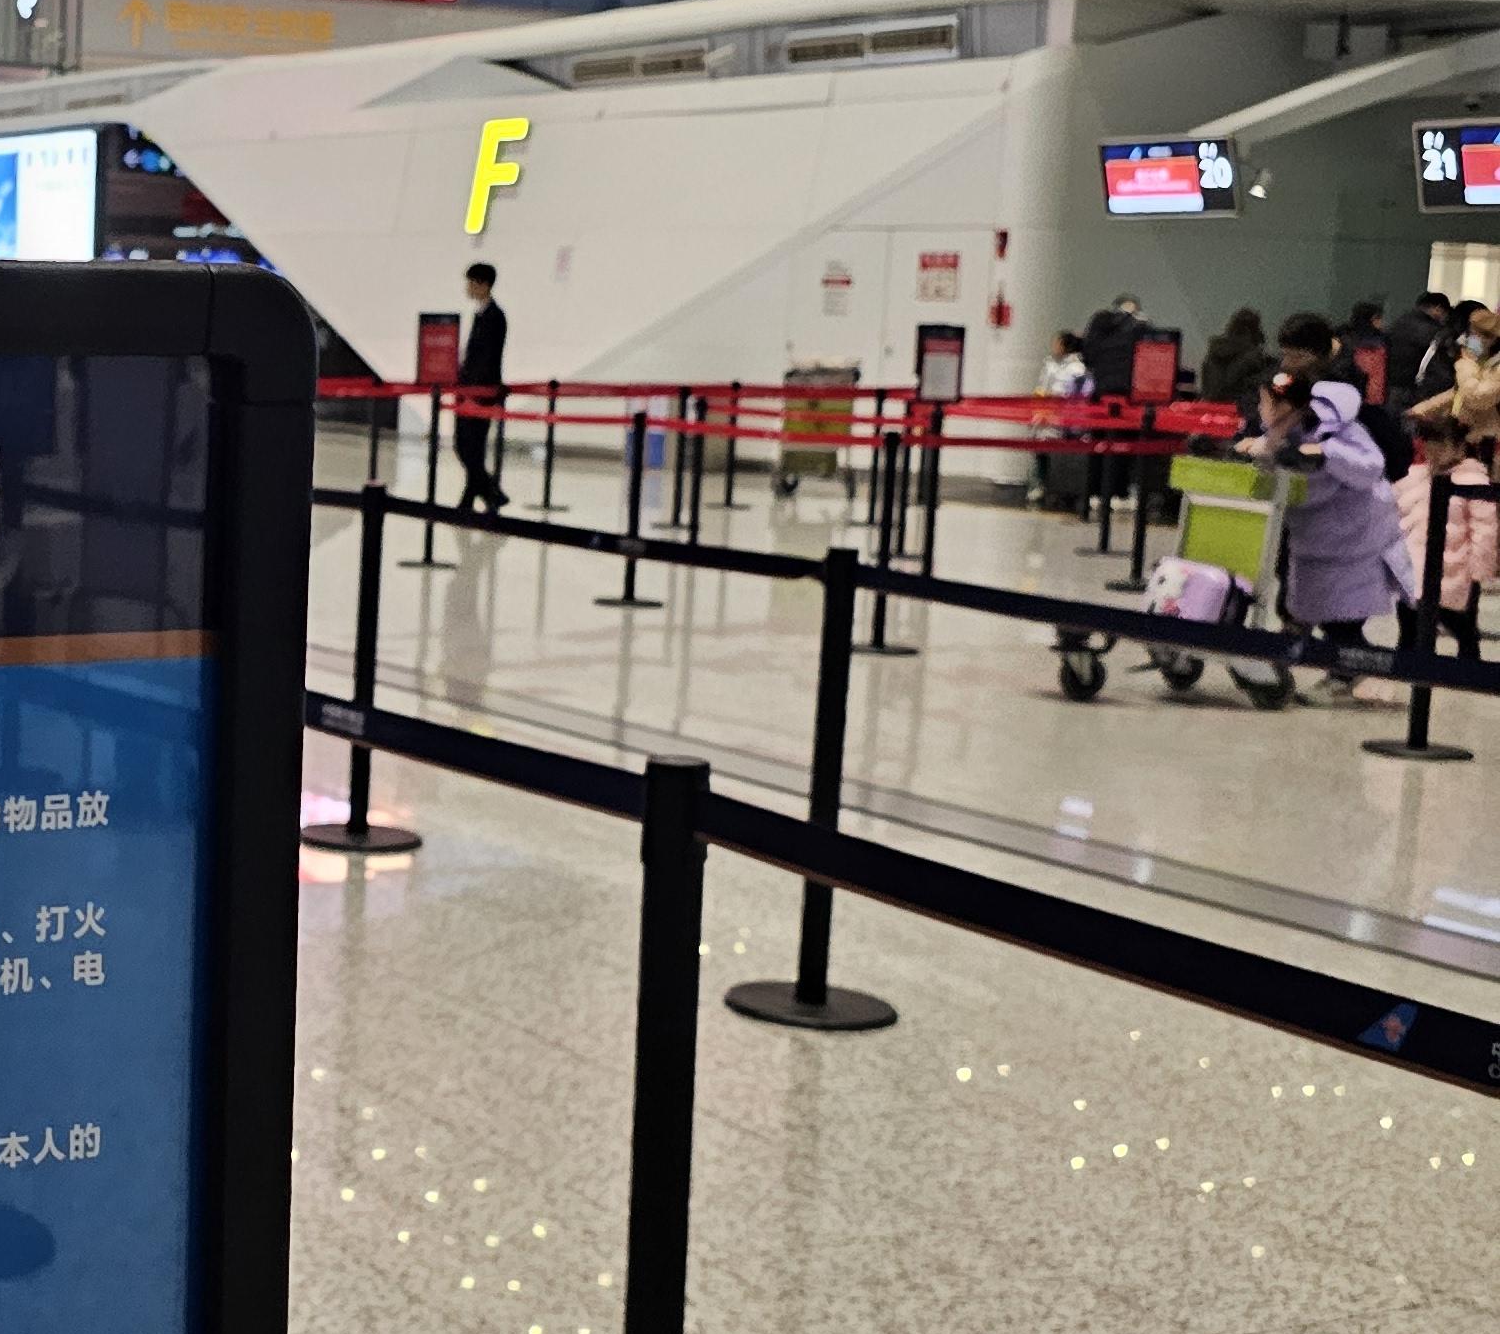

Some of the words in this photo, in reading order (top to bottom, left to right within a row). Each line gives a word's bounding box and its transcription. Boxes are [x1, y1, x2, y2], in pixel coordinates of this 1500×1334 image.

[463, 117, 530, 235] F
[1199, 156, 1232, 188] 20
[1422, 147, 1457, 181] 21
